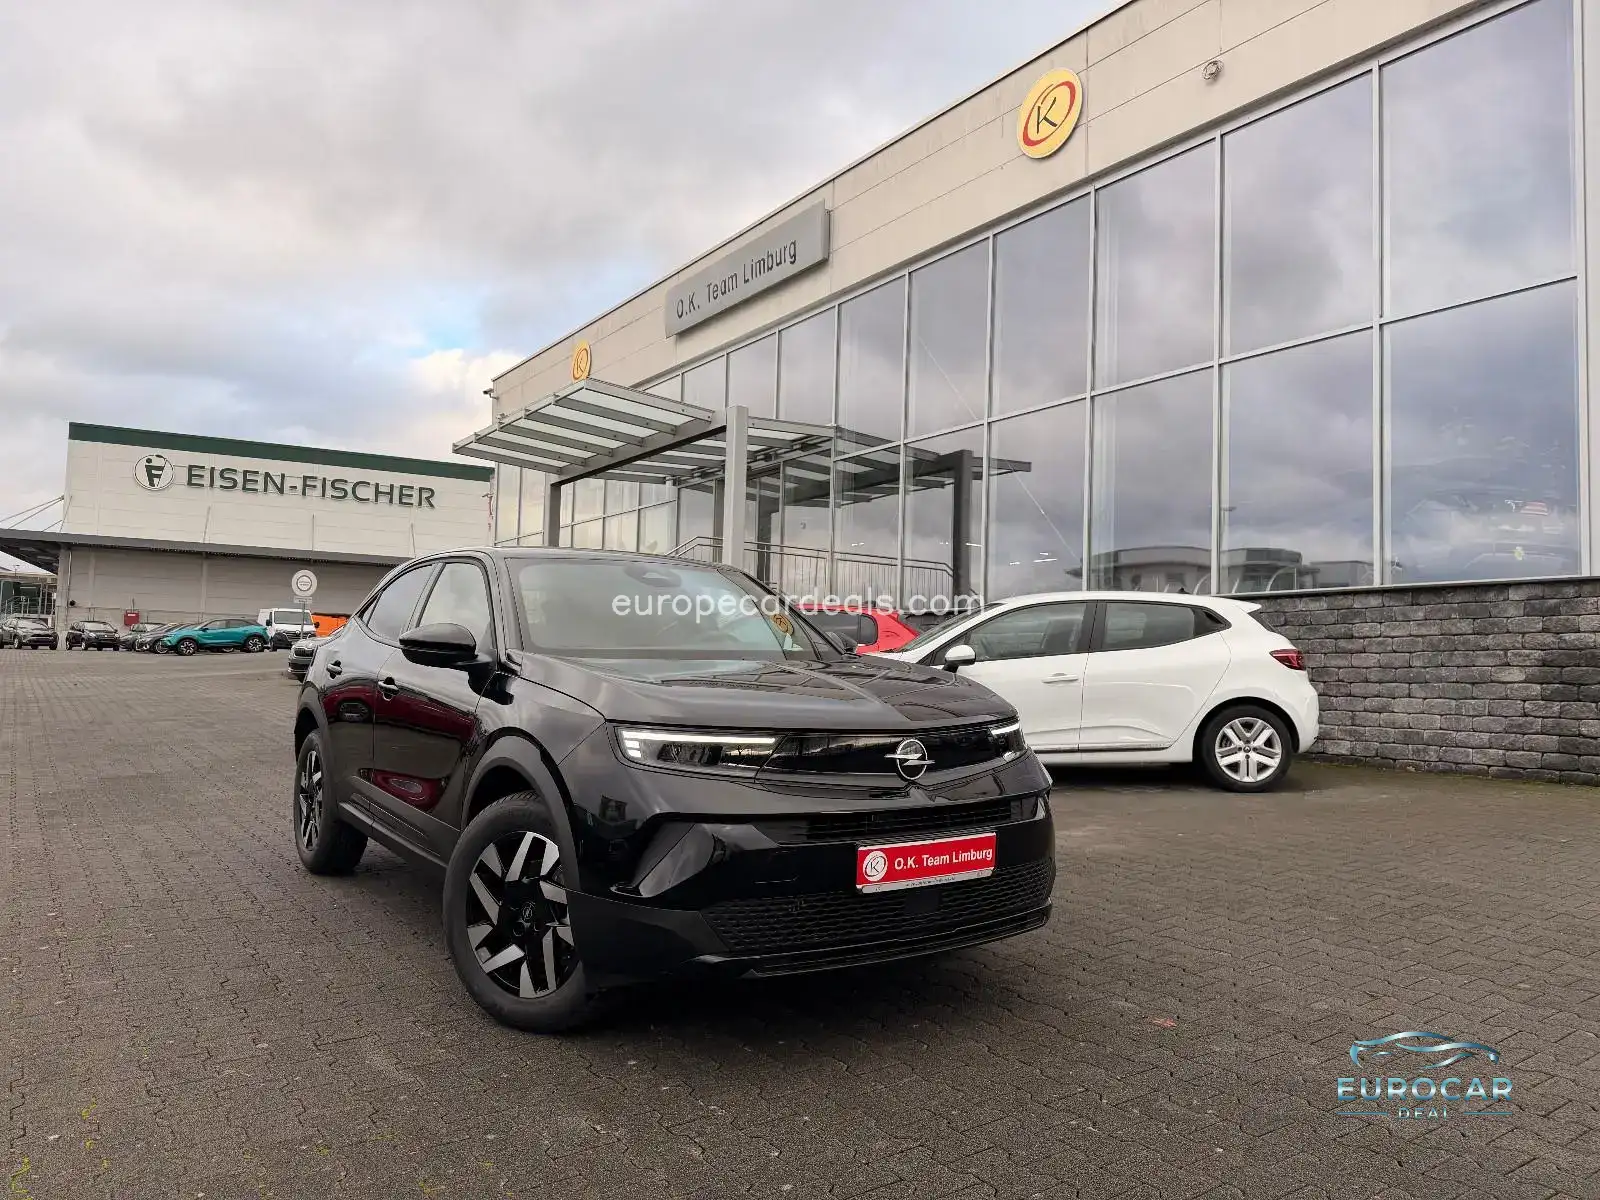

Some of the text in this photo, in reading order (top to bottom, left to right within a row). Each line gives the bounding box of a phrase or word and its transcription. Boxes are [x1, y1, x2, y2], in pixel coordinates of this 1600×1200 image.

[676, 239, 797, 319] O.K. Team Limburg
[186, 464, 436, 509] EISEN-FISCHER
[894, 856, 919, 870] O.K.
[922, 853, 950, 867] Team
[952, 848, 993, 863] Limburg
